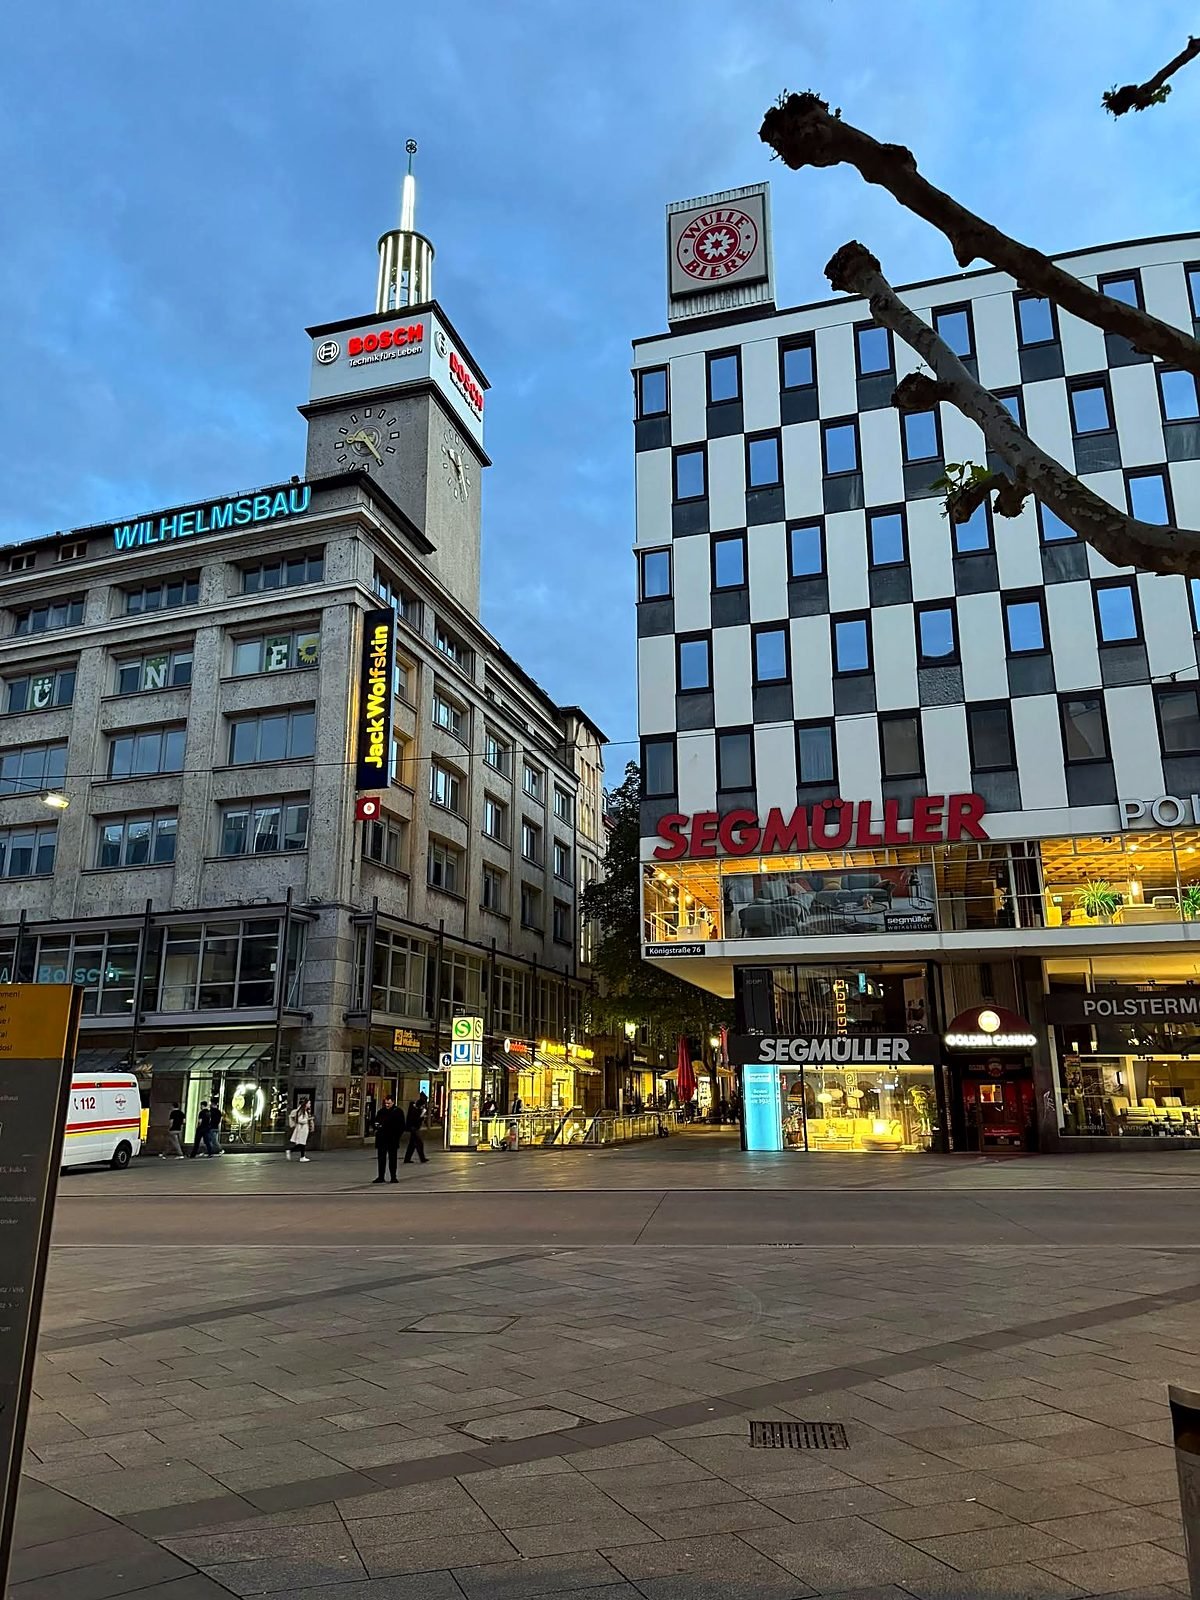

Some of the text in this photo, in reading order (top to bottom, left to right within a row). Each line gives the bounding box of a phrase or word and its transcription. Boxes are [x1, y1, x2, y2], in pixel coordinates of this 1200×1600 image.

[683, 211, 749, 240] WULLE
[685, 248, 750, 278] BIERE
[347, 322, 423, 357] BOSCH
[349, 346, 422, 368] Technik fürs Leben
[114, 485, 312, 550] WILHELMSBAU
[652, 793, 990, 861] SEGMÜLLER
[887, 914, 932, 924] segmüller
[650, 946, 691, 955] Königstraße
[1083, 998, 1200, 1017] POLSTERM
[758, 1037, 911, 1062] SEGMÜLLER
[992, 1034, 1037, 1046] CASINO
[80, 1096, 95, 1110] 112
